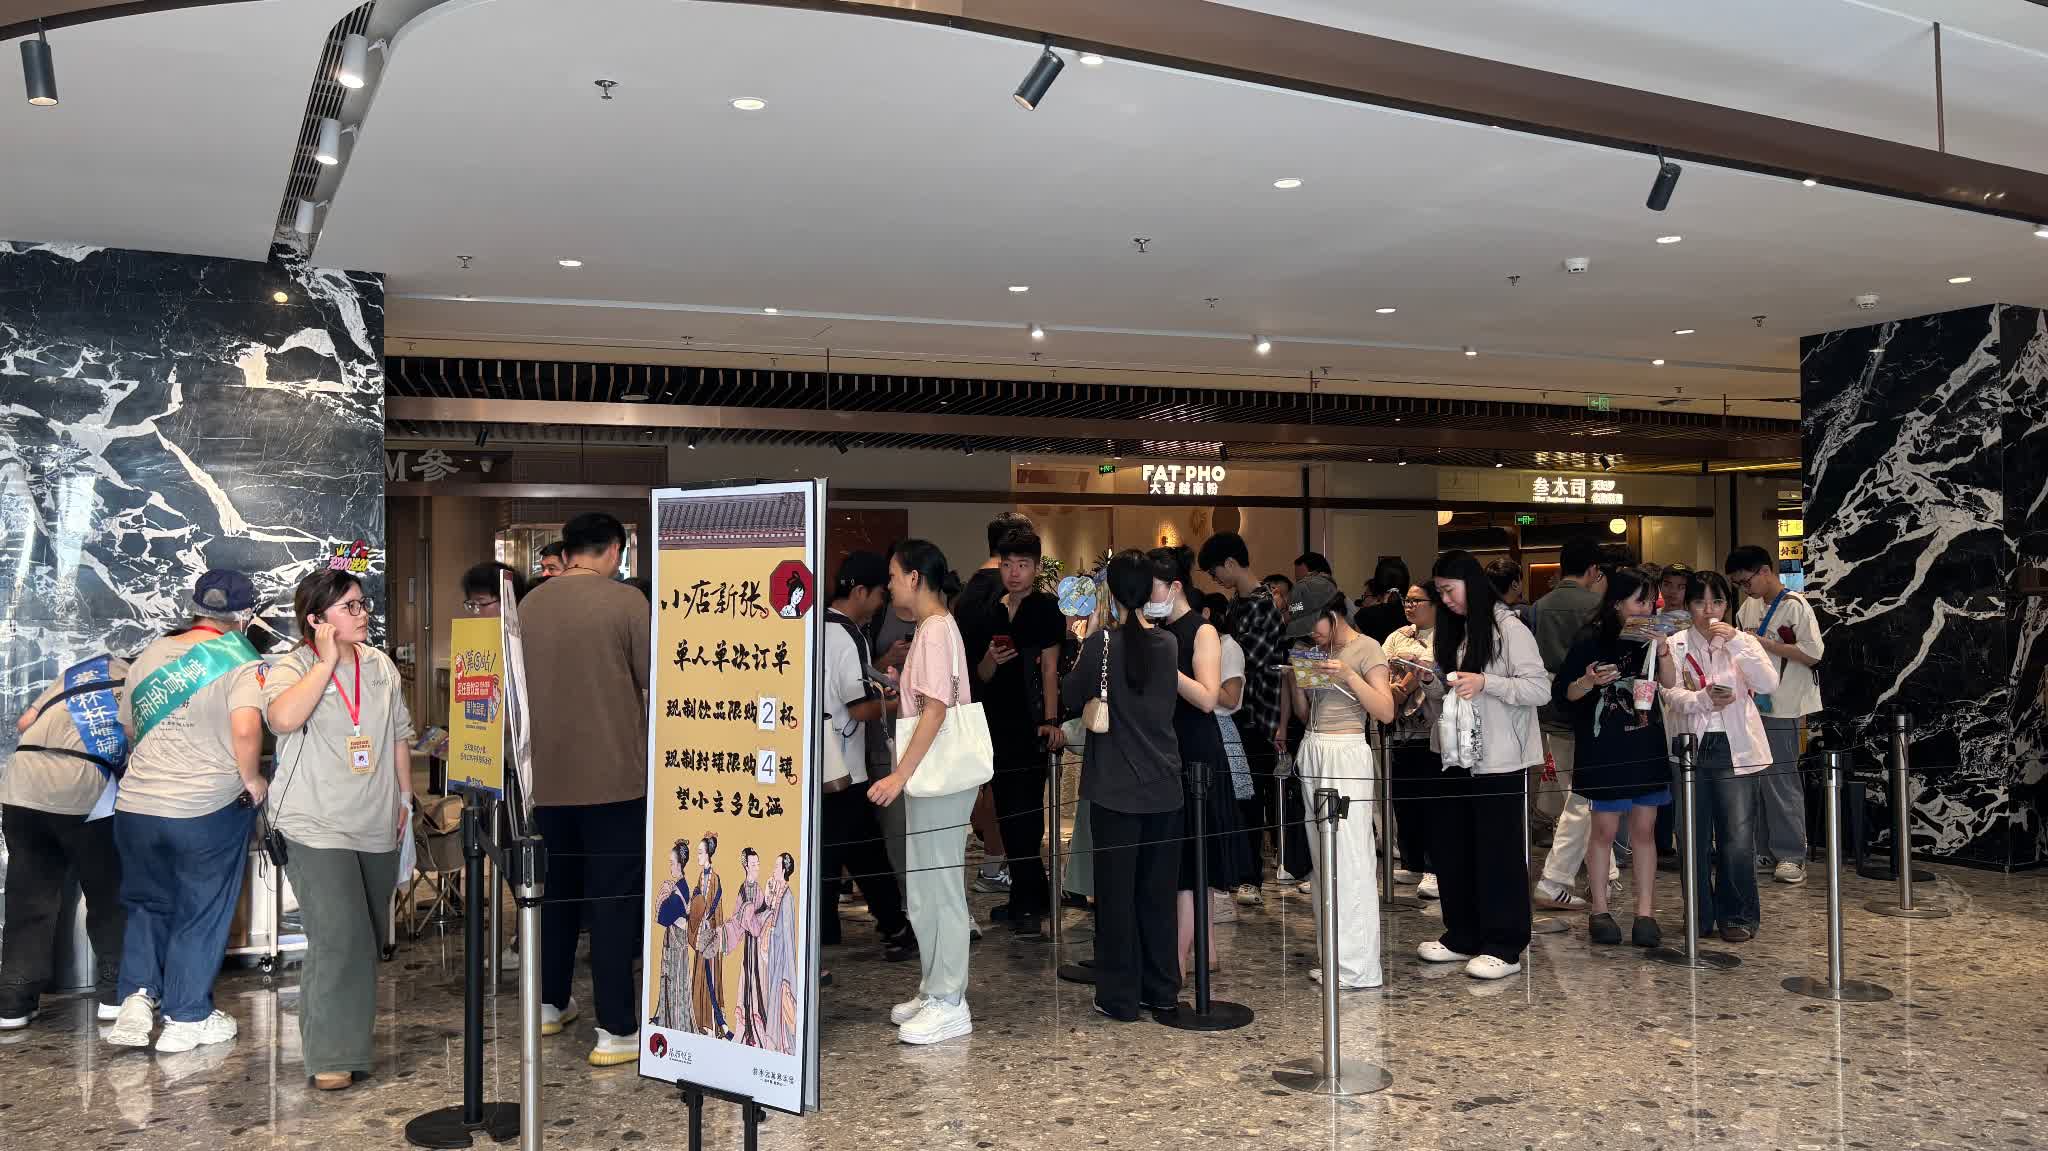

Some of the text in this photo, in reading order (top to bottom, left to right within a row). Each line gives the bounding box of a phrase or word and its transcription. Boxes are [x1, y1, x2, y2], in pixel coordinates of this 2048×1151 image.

[1142, 465, 1226, 481] FAT PHO
[674, 639, 790, 675] 单人单次订单
[666, 697, 797, 728] 现制饮品限购2杯
[675, 786, 784, 818] 望小主多包涵
